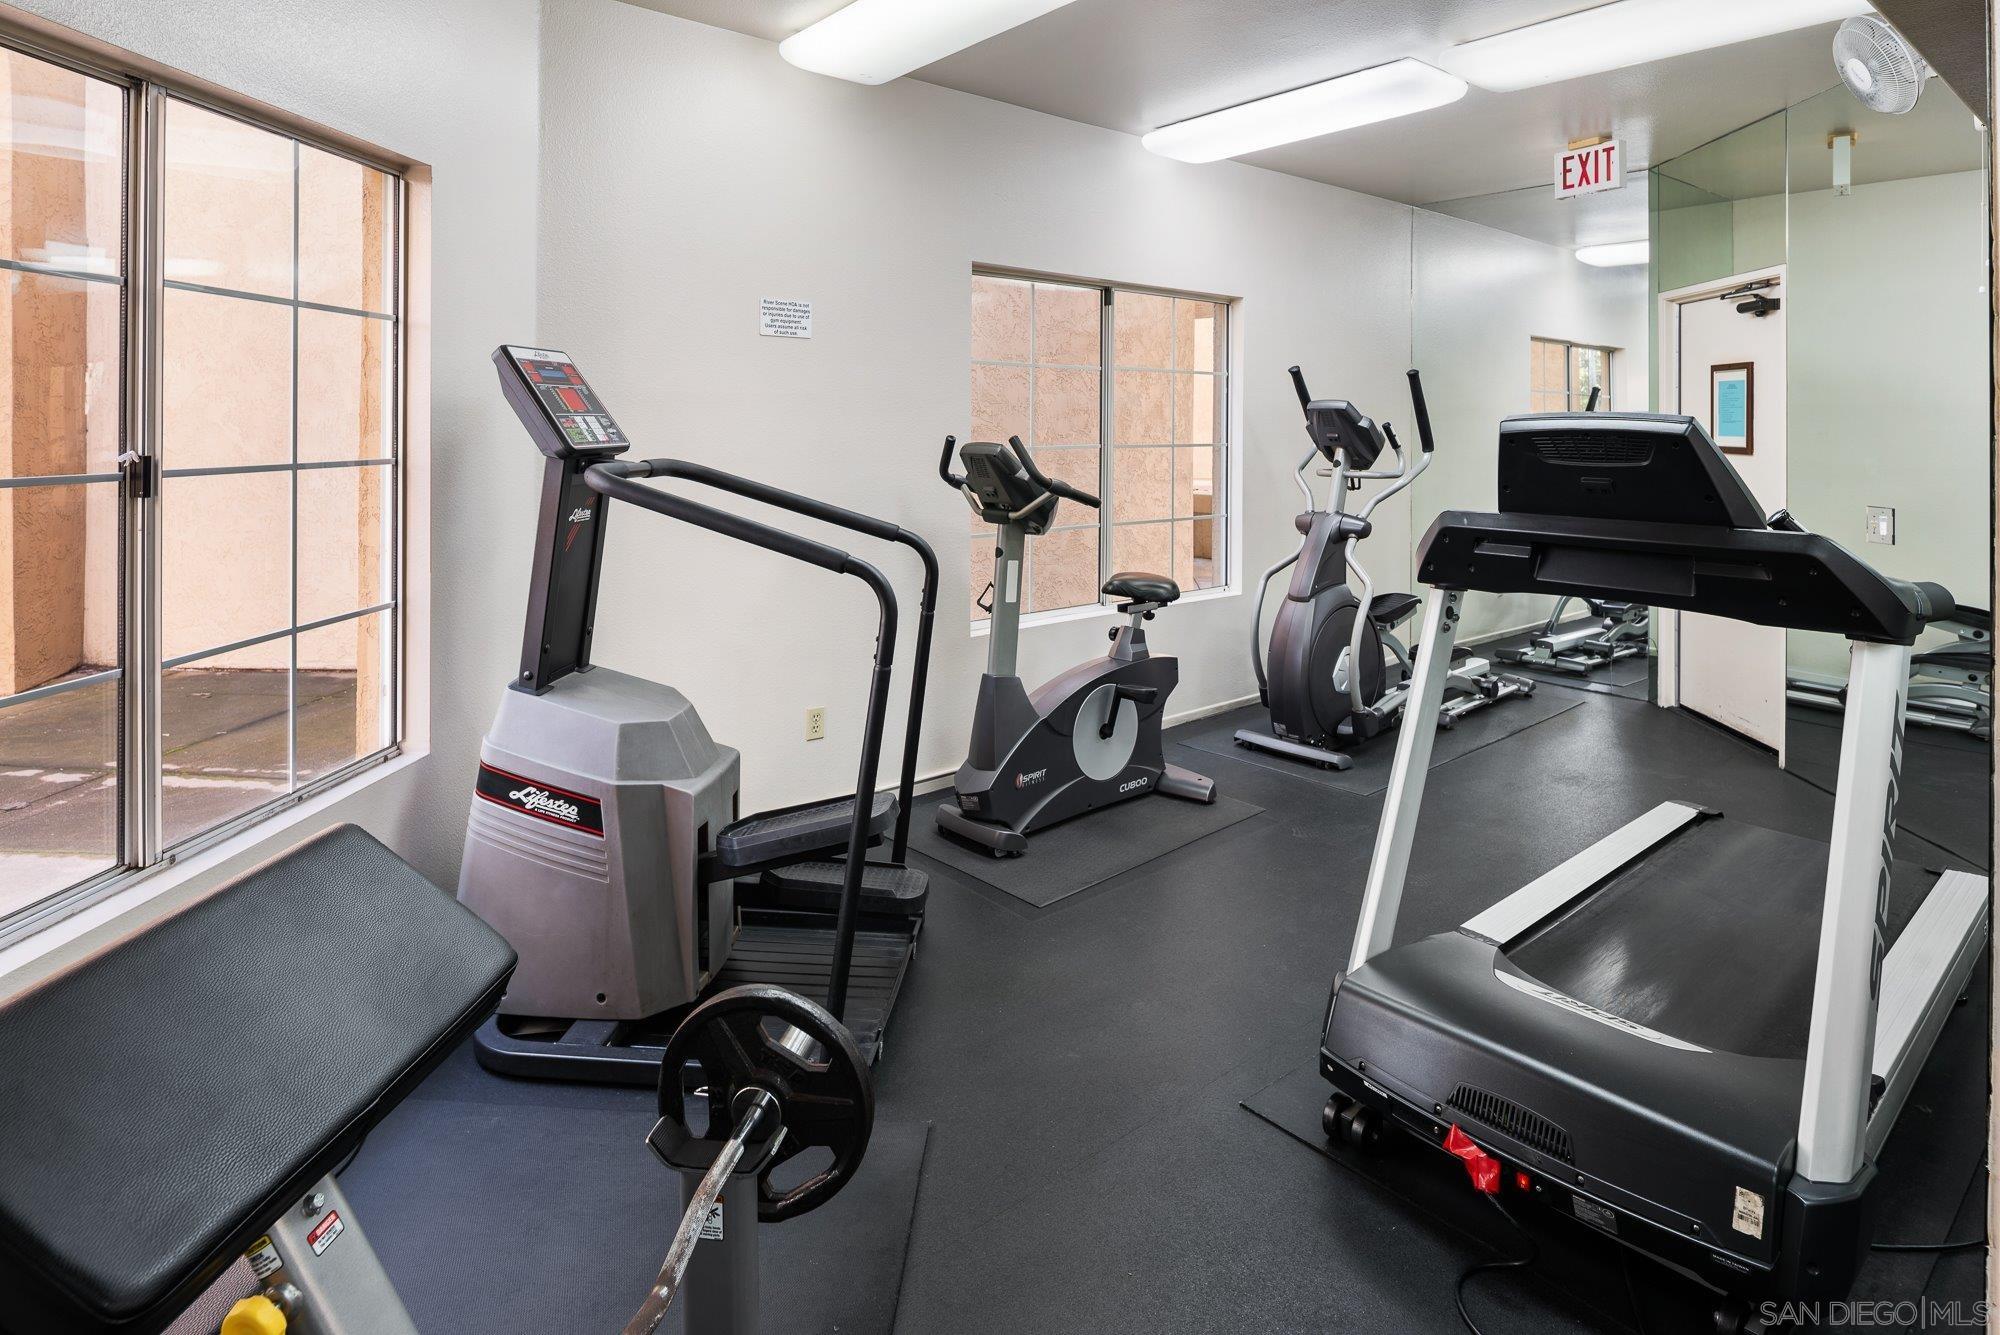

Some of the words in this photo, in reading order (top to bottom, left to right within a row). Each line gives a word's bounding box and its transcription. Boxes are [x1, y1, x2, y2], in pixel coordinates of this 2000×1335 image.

[1563, 146, 1615, 190] EXIT
[1022, 768, 1047, 783] SPIRIT
[1120, 777, 1148, 792] CU800
[509, 786, 578, 818] Lifestep
[1869, 689, 1905, 1012] SPIRIT
